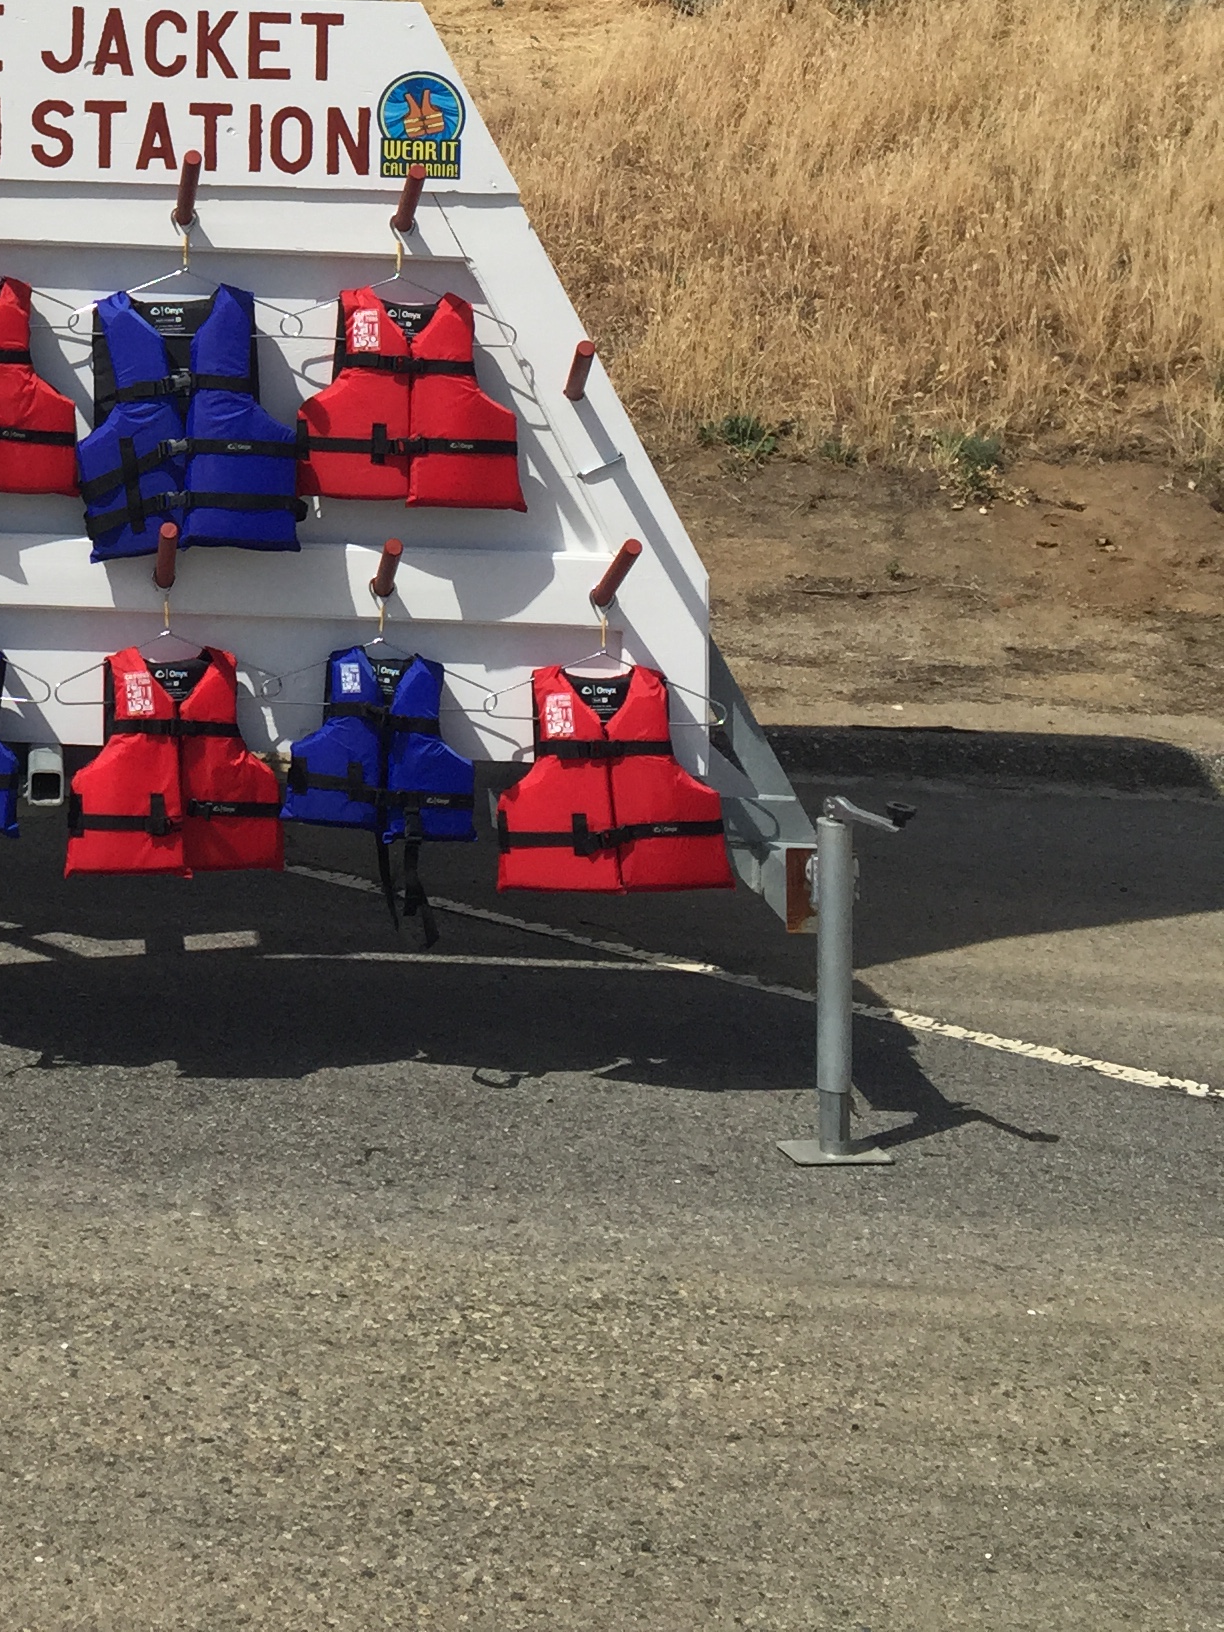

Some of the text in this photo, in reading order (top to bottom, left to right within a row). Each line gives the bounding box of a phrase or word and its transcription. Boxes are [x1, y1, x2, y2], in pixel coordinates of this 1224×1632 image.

[42, 7, 343, 80] JACKET
[32, 100, 370, 175] STATION
[383, 140, 459, 161] WEAR IT
[383, 162, 459, 178] CALIRNIA!
[164, 306, 184, 315] Onyx
[401, 310, 421, 320] Onyx
[597, 686, 617, 695] Onyx
